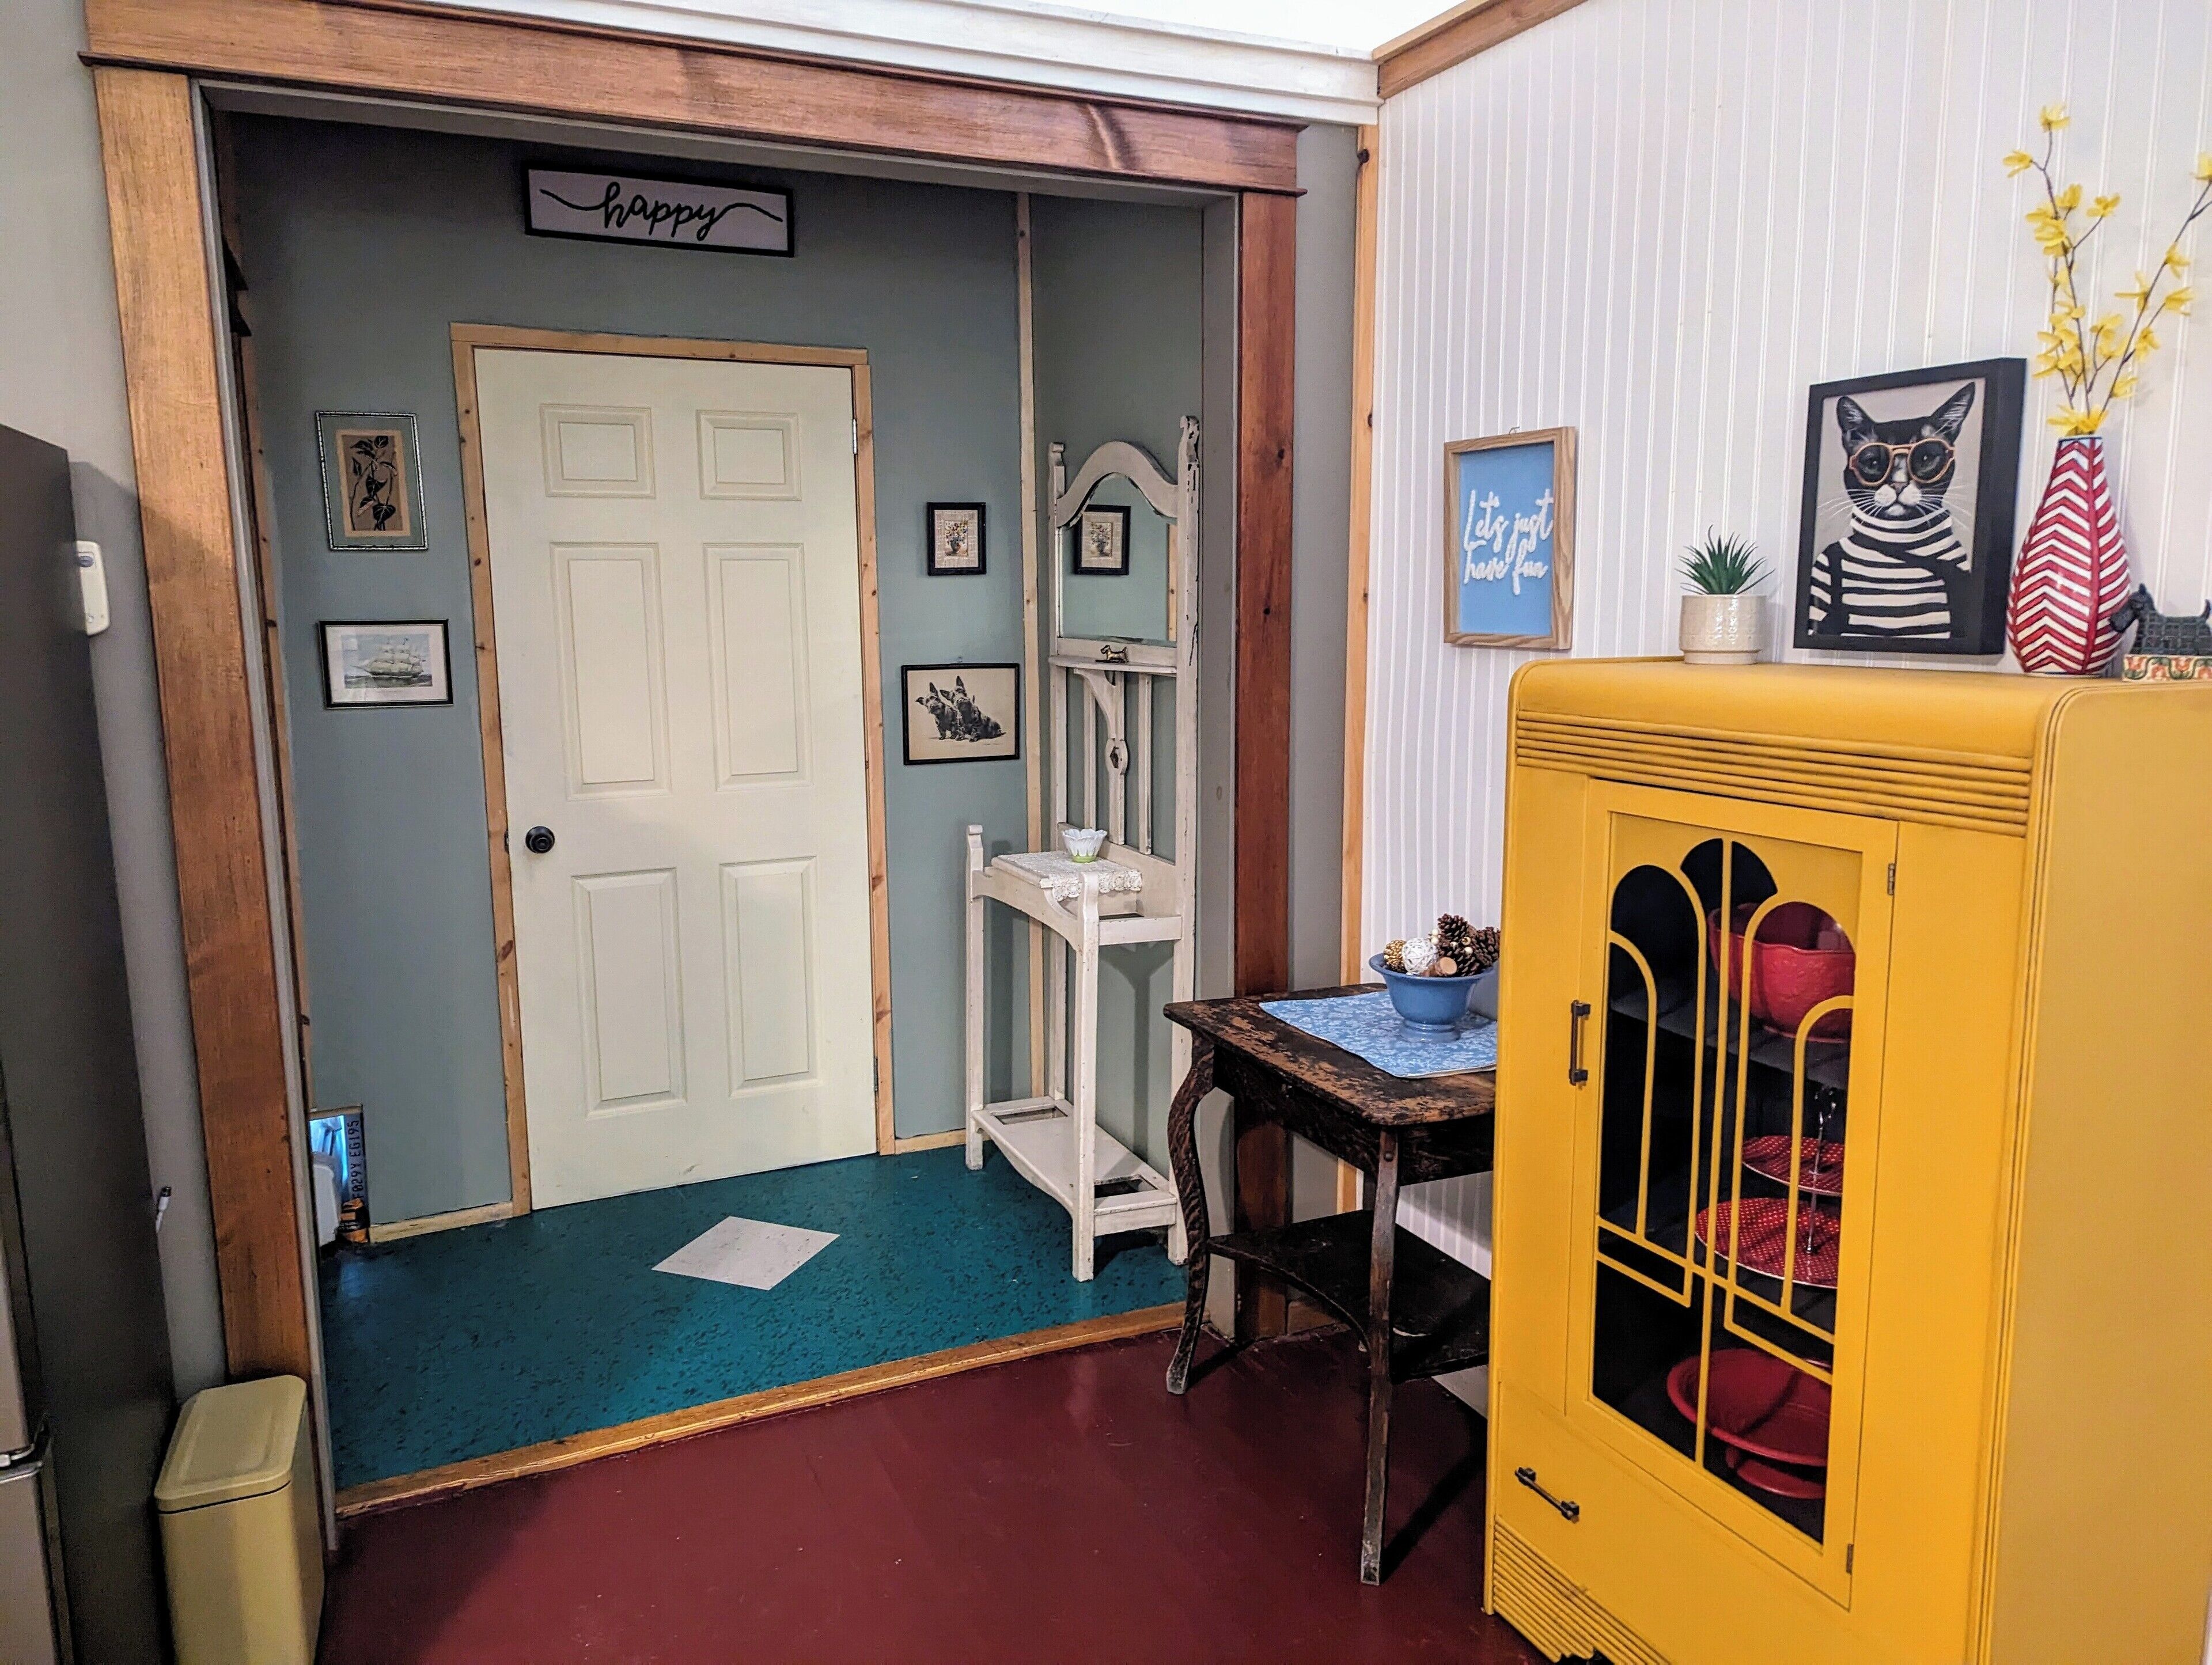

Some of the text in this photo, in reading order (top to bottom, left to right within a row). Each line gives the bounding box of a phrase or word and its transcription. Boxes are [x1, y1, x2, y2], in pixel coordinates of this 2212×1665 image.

[1505, 489, 1554, 565] just
[1463, 538, 1548, 596] have fun
